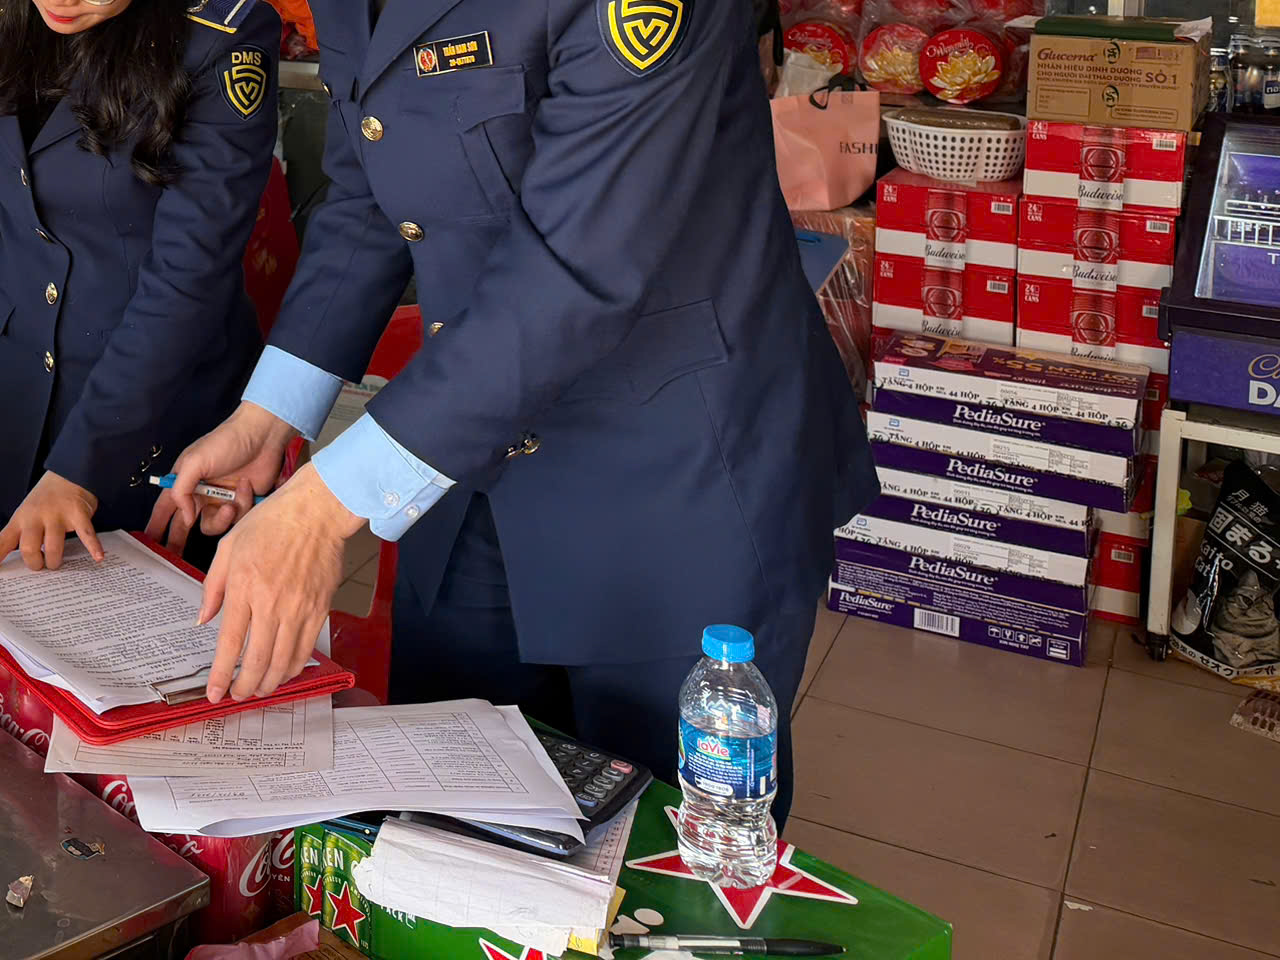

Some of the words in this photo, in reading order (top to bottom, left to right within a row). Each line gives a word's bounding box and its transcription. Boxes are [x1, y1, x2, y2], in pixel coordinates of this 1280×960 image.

[231, 51, 262, 65] DMS
[1037, 47, 1096, 62] Glucerna
[1172, 74, 1178, 85] 1
[1032, 121, 1042, 131] 24
[1032, 133, 1047, 141] CANS
[884, 185, 892, 193] 24
[1027, 203, 1037, 213] 24
[1027, 214, 1042, 223] CANS
[881, 260, 890, 269] 24
[881, 270, 893, 278] CANS
[1025, 284, 1035, 294] 24
[1025, 295, 1039, 303] CANS
[914, 382, 934, 394] HỘP
[948, 390, 959, 399] 44
[960, 390, 980, 402] HỘP
[1039, 402, 1060, 414] HỘP
[1075, 410, 1085, 418] 44
[1088, 409, 1109, 421] HỘP
[954, 404, 1040, 431] PediaSure
[946, 459, 1033, 486] PediaSure
[911, 504, 997, 532] PediaSure
[1033, 510, 1054, 522] HỘP
[909, 556, 995, 585] PediaSure
[839, 591, 892, 611] PediaSure
[697, 739, 730, 757] laVie
